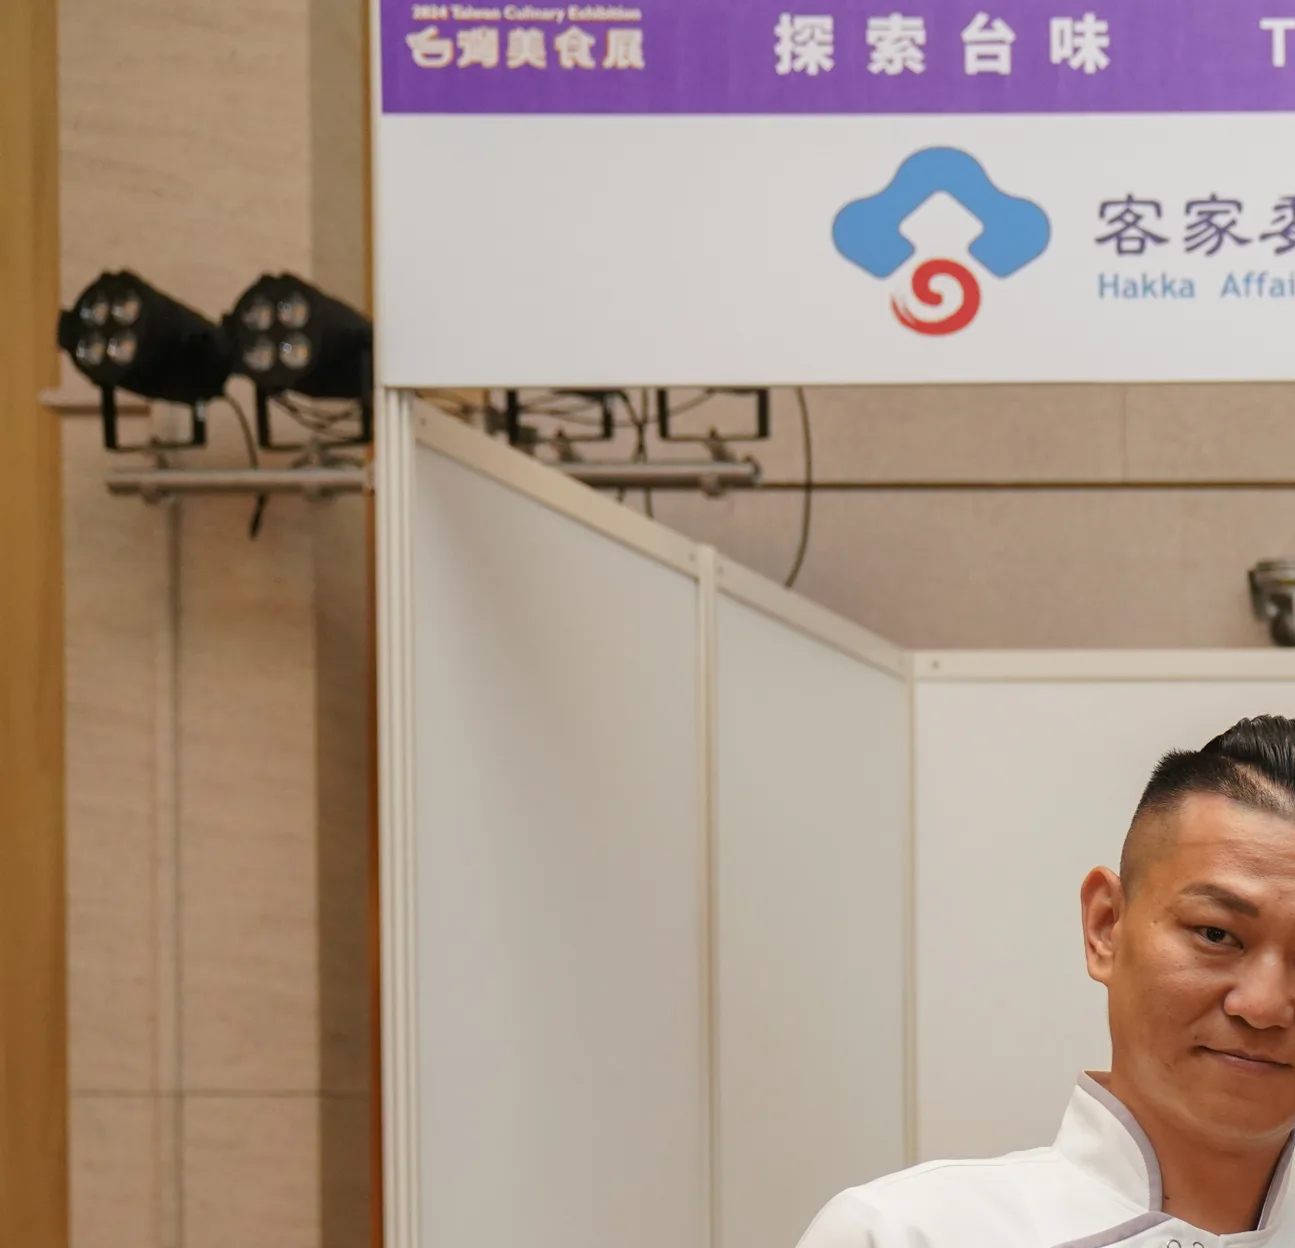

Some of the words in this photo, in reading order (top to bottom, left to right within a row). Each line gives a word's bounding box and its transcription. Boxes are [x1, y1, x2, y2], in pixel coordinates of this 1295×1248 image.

[503, 5, 566, 24] Culinary
[567, 5, 643, 22] Exhibition
[405, 26, 647, 70] 台灣美食展
[774, 13, 1112, 77] 探索台味
[1099, 274, 1197, 300] Hakka
